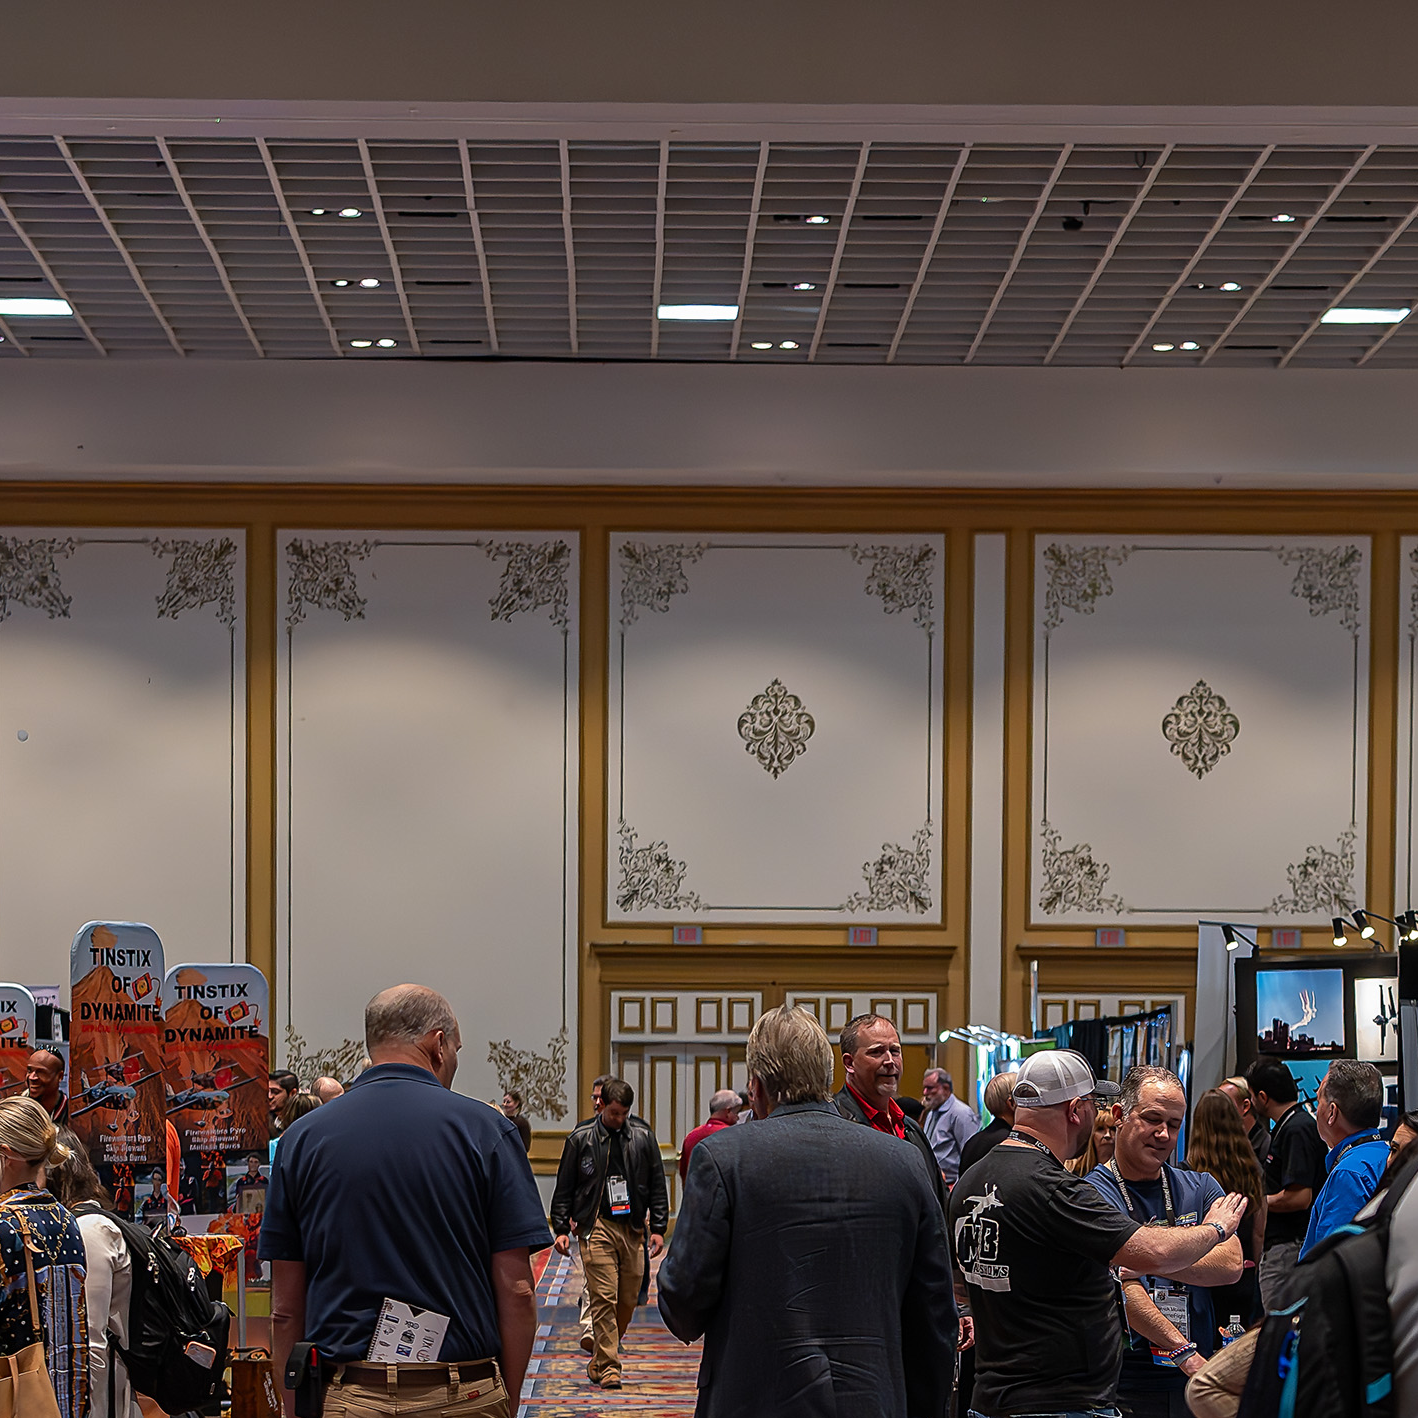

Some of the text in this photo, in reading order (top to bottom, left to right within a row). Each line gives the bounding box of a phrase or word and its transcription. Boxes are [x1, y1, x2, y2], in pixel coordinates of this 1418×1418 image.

[89, 947, 152, 967] TINSTIX
[111, 976, 131, 994] OF
[174, 982, 249, 1001] TINSTIX
[80, 1002, 162, 1022] DYNAMITE
[200, 1006, 224, 1021] OF
[164, 1025, 261, 1043] DYNAMITE
[1034, 1140, 1051, 1155] ICAS
[1110, 1159, 1134, 1211] Kimmel Insurance
[1164, 1187, 1173, 1211] Kimmel
